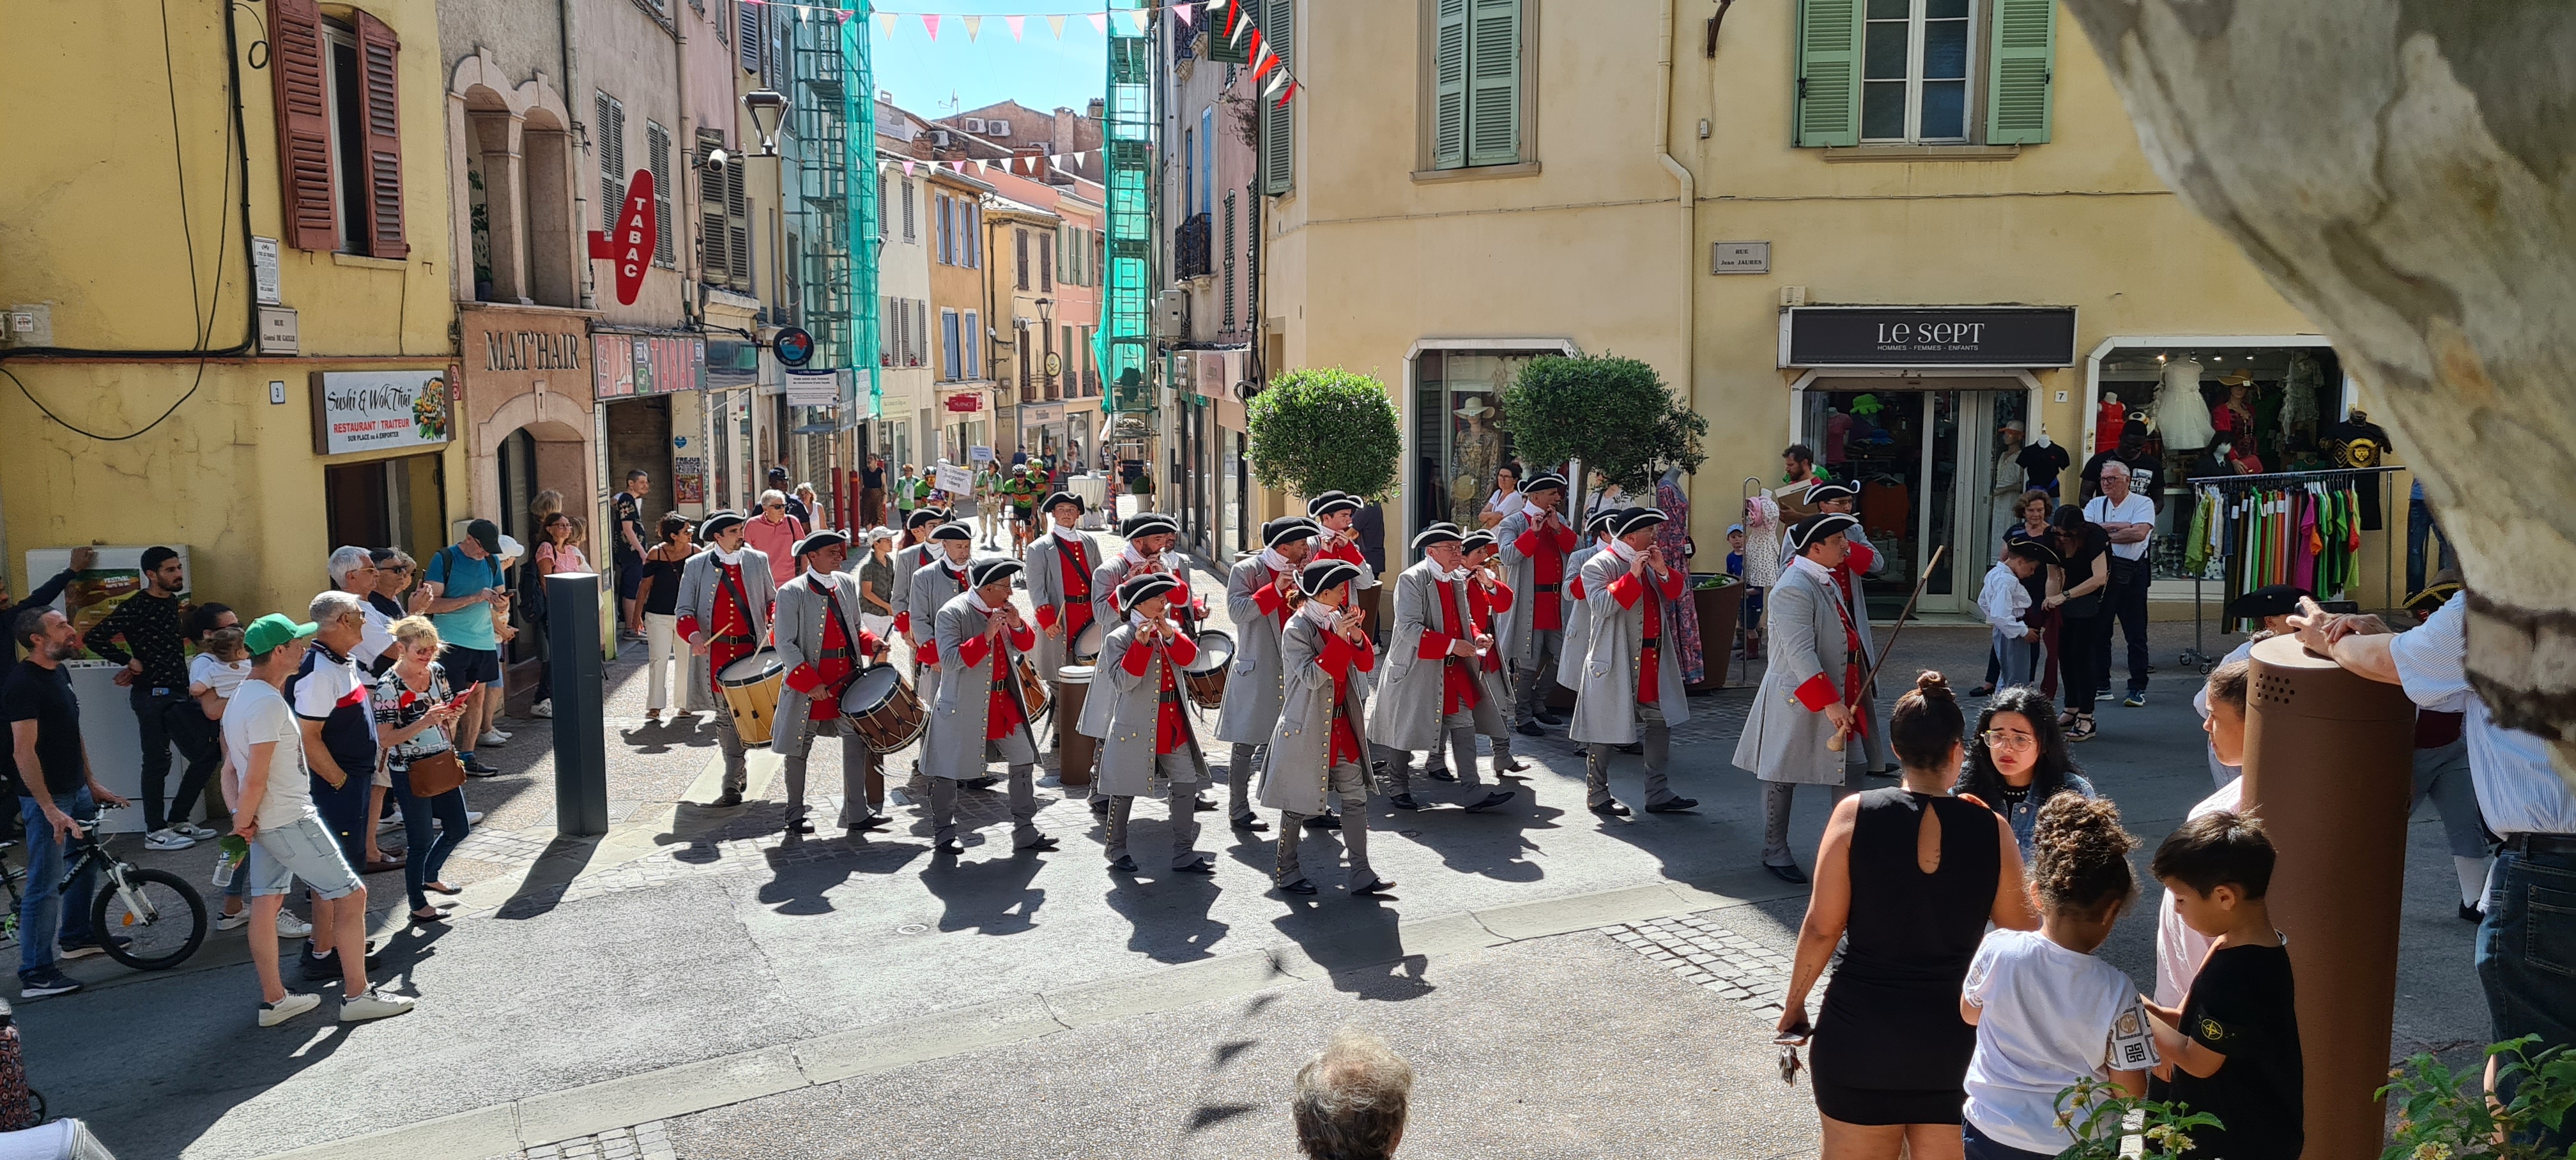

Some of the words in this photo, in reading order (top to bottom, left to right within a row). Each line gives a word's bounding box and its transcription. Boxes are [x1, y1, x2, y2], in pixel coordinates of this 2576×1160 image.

[624, 197, 646, 277] TABAC
[484, 330, 580, 371] MAT'HAIR
[650, 337, 695, 393] TABAC
[275, 387, 279, 397] 3
[327, 388, 356, 411] Sushi
[358, 390, 368, 416] &
[369, 384, 391, 410] Wok
[390, 386, 412, 411] Thaï
[539, 393, 542, 409] 7
[334, 420, 376, 434] RESTAURANT
[381, 418, 410, 429] TRAITEUR
[379, 431, 399, 439] EMPORTER
